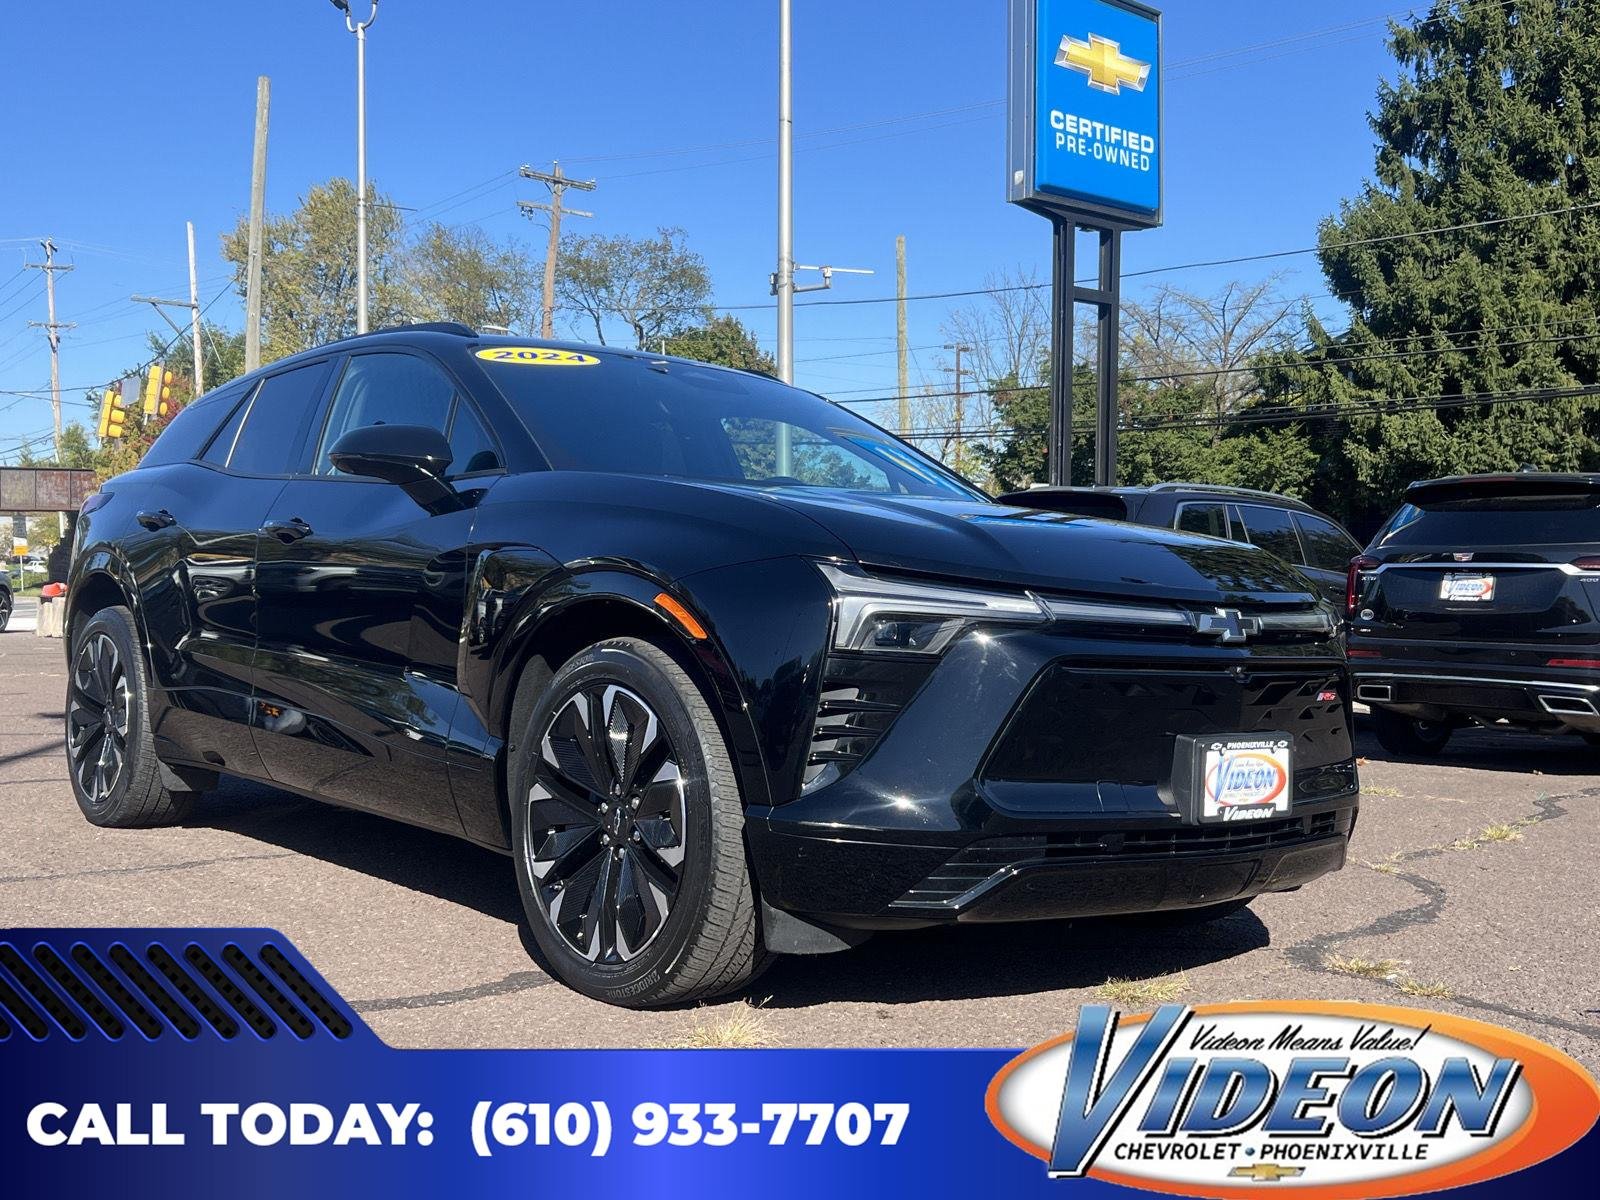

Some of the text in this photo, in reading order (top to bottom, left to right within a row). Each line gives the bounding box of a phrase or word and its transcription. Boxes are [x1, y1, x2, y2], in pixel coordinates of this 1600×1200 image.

[1050, 109, 1155, 153] CERTIFIED
[1055, 133, 1150, 172] PRE-OWNED
[493, 351, 587, 363] 2024
[1227, 741, 1274, 749] PHOENIXVILLE
[1214, 755, 1276, 802] VIDEON
[1223, 806, 1275, 821] VIDEON
